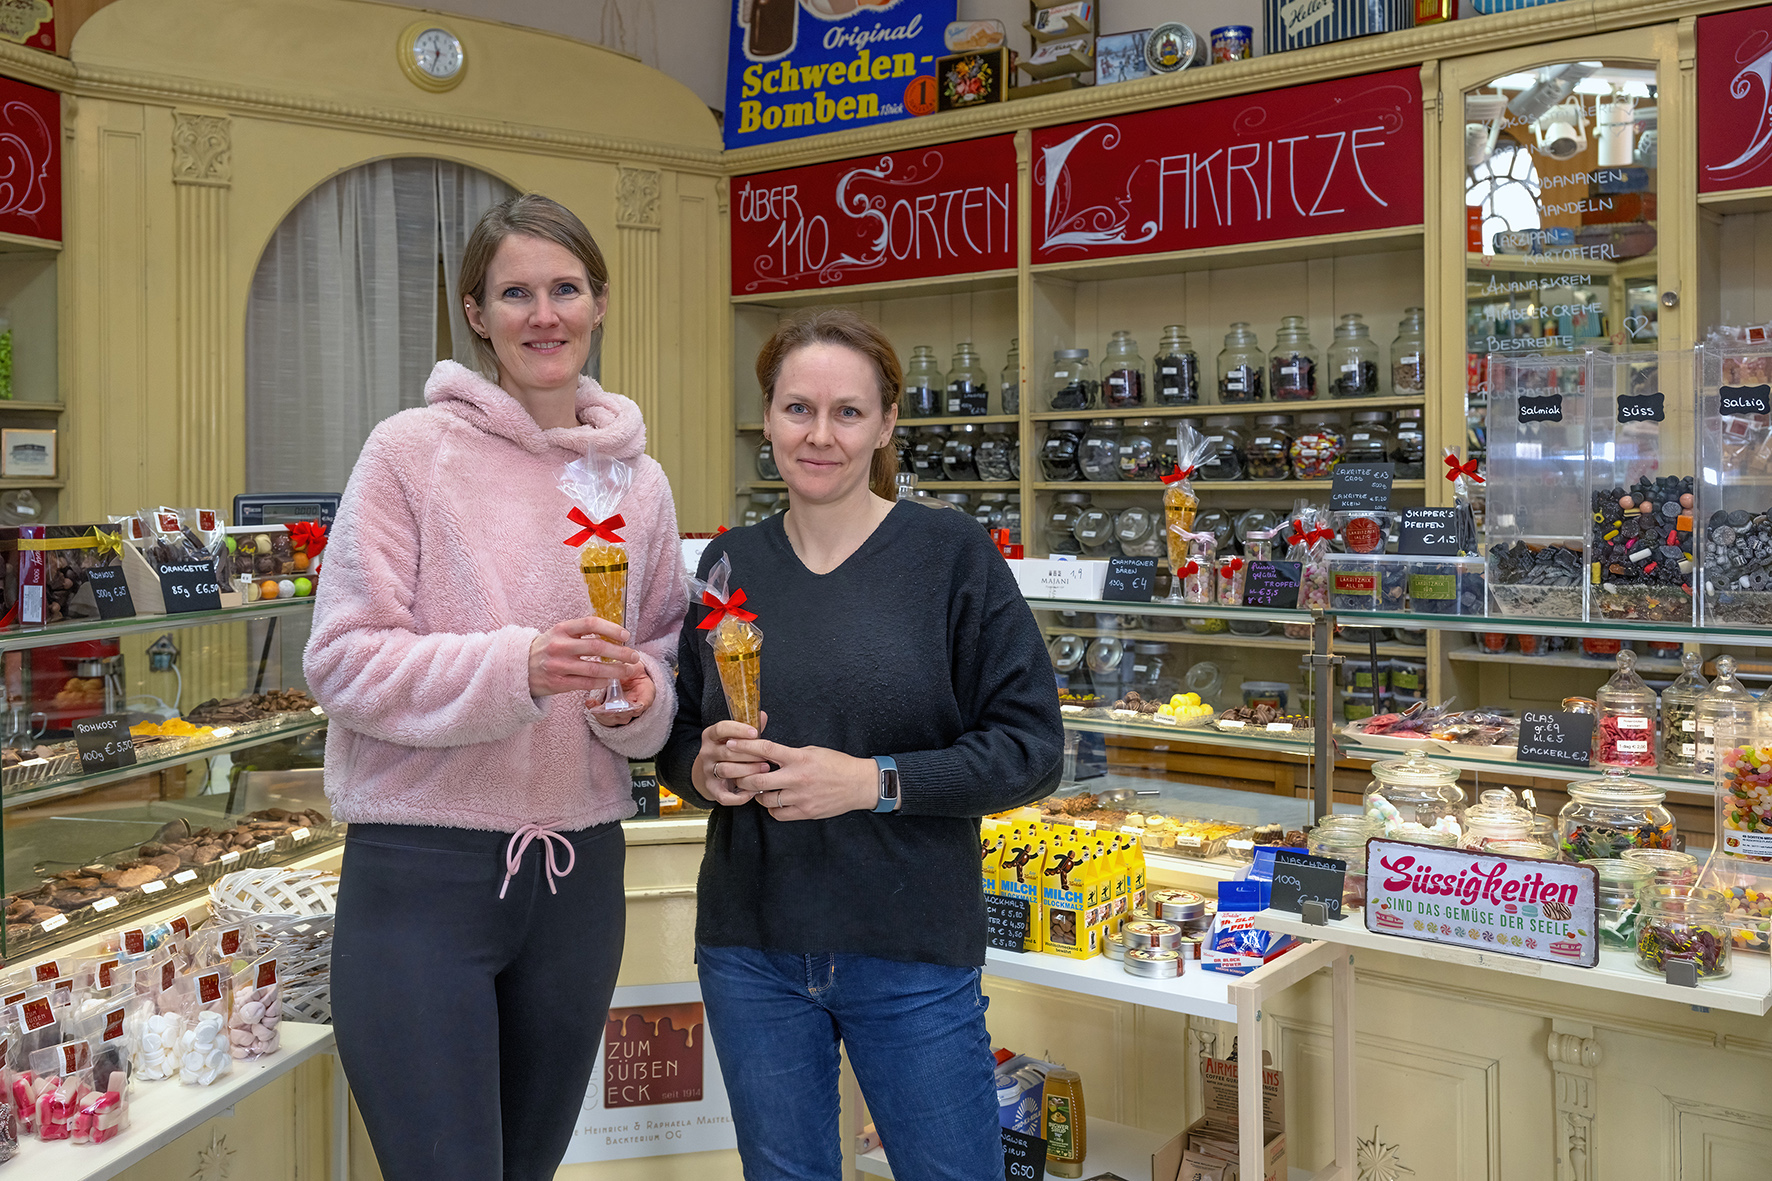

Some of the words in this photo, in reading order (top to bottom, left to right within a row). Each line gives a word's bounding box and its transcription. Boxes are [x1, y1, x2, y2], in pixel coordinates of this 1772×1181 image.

[822, 14, 923, 51] Original
[741, 49, 933, 98] Schweden-
[738, 92, 880, 133] Bomben
[1039, 123, 1388, 250] LAKRITZE
[738, 181, 802, 222] ÜBER
[836, 156, 1009, 264] SORTEN
[767, 215, 829, 275] 110
[1551, 302, 1604, 319] CREME
[1486, 335, 1574, 352] BESTREUTE
[1405, 510, 1455, 518] SKIPPER'S
[160, 563, 210, 574] ORANGETTE
[1111, 559, 1154, 567] CHAMPAGNER
[1041, 577, 1069, 585] MAJANI
[171, 585, 191, 598] 85g
[1524, 712, 1554, 723] GLAS
[76, 720, 118, 734] ROHKOST
[82, 750, 105, 762] 100g
[1521, 745, 1571, 759] SACKERL
[633, 779, 656, 788] NEN
[1281, 855, 1338, 873] NASCHBAR
[1001, 880, 1037, 896] MILCH
[1274, 875, 1302, 892] 100g
[1380, 855, 1579, 907] Süssigkeiten
[1043, 887, 1084, 904] MILCH
[1043, 899, 1084, 911] BLOCKMALZ
[1386, 897, 1413, 912] SIND
[1418, 901, 1440, 917] DAS
[1445, 905, 1495, 926] GEMÜSE
[1500, 915, 1524, 930] DER
[1529, 919, 1570, 936] SEELE
[607, 1040, 650, 1060] ZUM
[1205, 1057, 1238, 1078] AIRME
[607, 1084, 650, 1105] ECK
[661, 1091, 679, 1100] seit
[634, 1121, 641, 1131] &
[665, 1130, 682, 1140] OG
[1002, 1144, 1026, 1157] SIRUP
